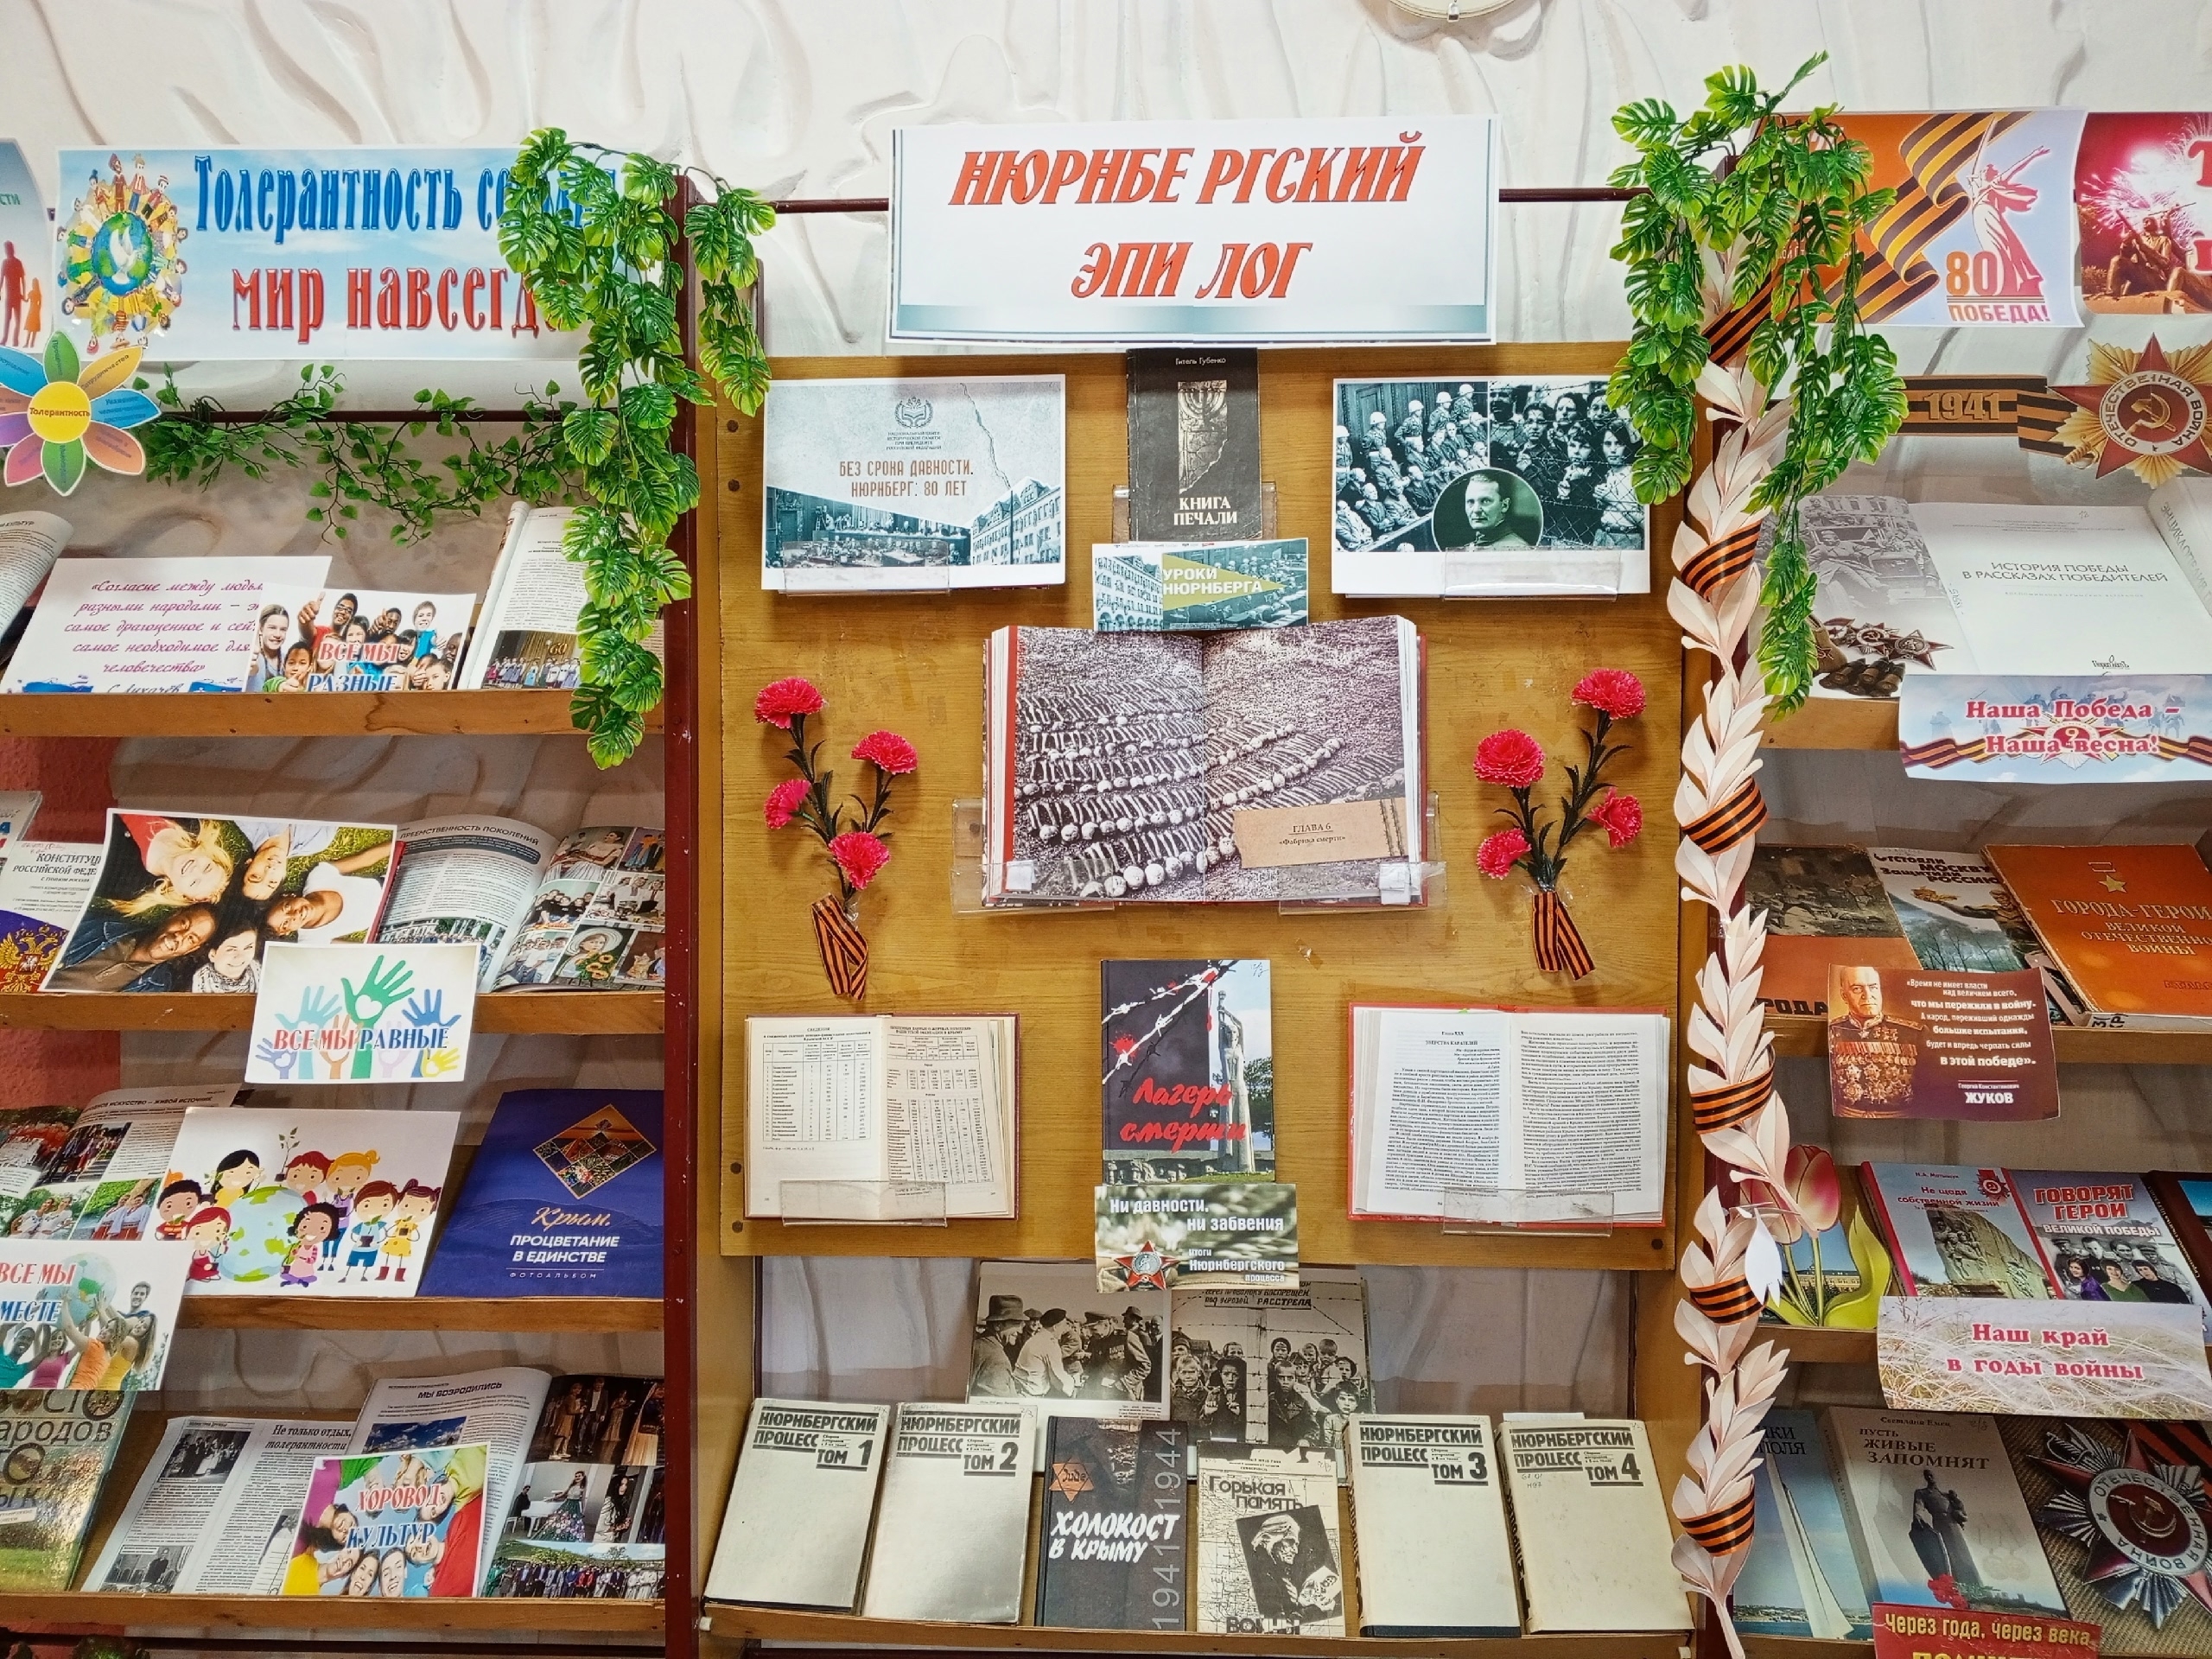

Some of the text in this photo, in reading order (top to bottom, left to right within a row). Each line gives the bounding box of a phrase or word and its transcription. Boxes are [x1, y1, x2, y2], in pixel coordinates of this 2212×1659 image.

[948, 131, 1426, 205] НЮРНБЕ РГСКИЙ
[194, 155, 462, 245] Толерантность
[1071, 242, 1313, 299] ЭПИ ЛОГ
[1946, 251, 1999, 296] 80
[232, 265, 563, 344] мир навсегд
[1948, 304, 2051, 324] ПОБЕДА!
[29, 408, 90, 417] Толерантность
[1923, 391, 2000, 421] 1941
[2171, 398, 2204, 448] ВОЙНА
[839, 458, 975, 477] БЕЗ СРОКА ДАВНОСТИ.
[851, 480, 967, 498] НЮРНБЕРГ: 80 ЛЕТ
[1179, 497, 1231, 511] КНИГА
[1173, 511, 1237, 526] ПЕЧАЛИ
[1163, 567, 1217, 580] УРОКИ
[1976, 571, 2056, 582] РАССКАЗАХ
[2060, 572, 2169, 582] ПОБЕДИТЕЛЕЙ
[1991, 563, 2129, 574] ИСТОРИЯ ПОБЕДЫ
[92, 579, 215, 596] «Согласие между
[1163, 581, 1263, 595] НЮРНБЕРГА
[77, 600, 221, 618] разными народами
[64, 620, 222, 638] самое драгоценное и
[73, 639, 251, 655] самое необходимое для
[318, 643, 399, 663] ВСЕ МЫ
[104, 662, 206, 674] человечества»
[308, 674, 397, 691] РАЗНЫЕ
[1966, 698, 2152, 720] Наша Победа
[1986, 734, 2160, 753] Наша весна!
[400, 824, 540, 846] ПРЕЕМСТВЕННОСТЬ ПОКОЛЕНИЙ
[1293, 823, 1325, 833] ГЛАВА
[1279, 836, 1345, 846] «Фабрика смерти»
[13, 864, 73, 874] РОССИЙСКОЙ
[1926, 874, 2000, 885] РОССИЮ
[2105, 922, 2187, 934] ВЕЛИКОЙ
[2126, 944, 2197, 956] ВОЙНЫ
[1944, 1001, 1993, 1011] пережили
[1999, 1013, 2035, 1022] однажды
[1932, 1025, 1972, 1034] большие
[273, 1027, 449, 1050] ВСЕ МЫ РАВНЫЕ
[1926, 1039, 1946, 1049] будет
[1940, 1055, 1975, 1066] в этой
[1132, 1077, 1233, 1119] Лагерь
[1965, 1091, 2014, 1104] ЖУКОВ
[1120, 1122, 1247, 1154] смерти
[1897, 1197, 1962, 1206] собственной
[2033, 1183, 2133, 1205] ГОВОРЯТ
[1109, 1198, 1209, 1214] Ни давности,
[2052, 1202, 2127, 1222] ГЕРОИ
[531, 1206, 612, 1232] Крым
[1186, 1217, 1284, 1231] ни забвения
[2043, 1224, 2161, 1237] ВЕЛИКОЙ ПОБЕДЫ
[510, 1236, 620, 1248] ПРОЦВЕТАНИЕ
[512, 1250, 607, 1264] В ЕДИНСТВЕ
[1188, 1249, 1211, 1257] итоги
[0, 1262, 77, 1285] ВСЕ МЫ
[1189, 1259, 1285, 1273] Нюрнбергского
[1244, 1274, 1285, 1283] процесса
[1257, 1298, 1312, 1306] РАССТРЕЛА
[1972, 1323, 2109, 1348] Наш край
[1948, 1359, 2144, 1380] в годы войны
[435, 1382, 502, 1398] ВОЗРОДИЛИСЬ
[758, 1410, 879, 1433] НЮРНБЕРГСКИЙ
[900, 1415, 1020, 1434] НЮРНБЕРГСКИЙ
[272, 1424, 352, 1439] Не только отдых,
[753, 1430, 819, 1448] ПРОЦЕСС
[1359, 1427, 1483, 1444] НЮРНБЕРГСКИЙ
[1511, 1431, 1635, 1448] НЮРНБЕРГСКИЙ
[1859, 1428, 1899, 1438] ПУСТЬ
[264, 1440, 347, 1452] толерантности
[817, 1439, 874, 1466] ТОМ 1
[897, 1436, 963, 1453] ПРОЦЕСС
[1863, 1439, 1936, 1452] ЖИВЫЕ
[963, 1441, 1020, 1471] ТОМ 2
[1360, 1446, 1429, 1463] ПРОЦЕСС
[1513, 1452, 1583, 1468] ПРОЦЕСС
[1867, 1451, 1990, 1470] ЗАПОМНЯТ
[1154, 1428, 1181, 1510] 1944
[1431, 1452, 1488, 1480] ТОМ 3
[1586, 1452, 1642, 1481] ТОМ 4
[1209, 1475, 1286, 1499] Горькая
[356, 1484, 442, 1511] ХОРОВОД
[1236, 1494, 1304, 1510] память
[1050, 1511, 1181, 1541] ХОЛОКОСТ
[346, 1522, 436, 1548] КУЛЬТУР
[1048, 1538, 1149, 1563] В КРЫМУ
[1152, 1544, 1180, 1630] 1941
[1885, 1613, 2090, 1647] Через года, через века
